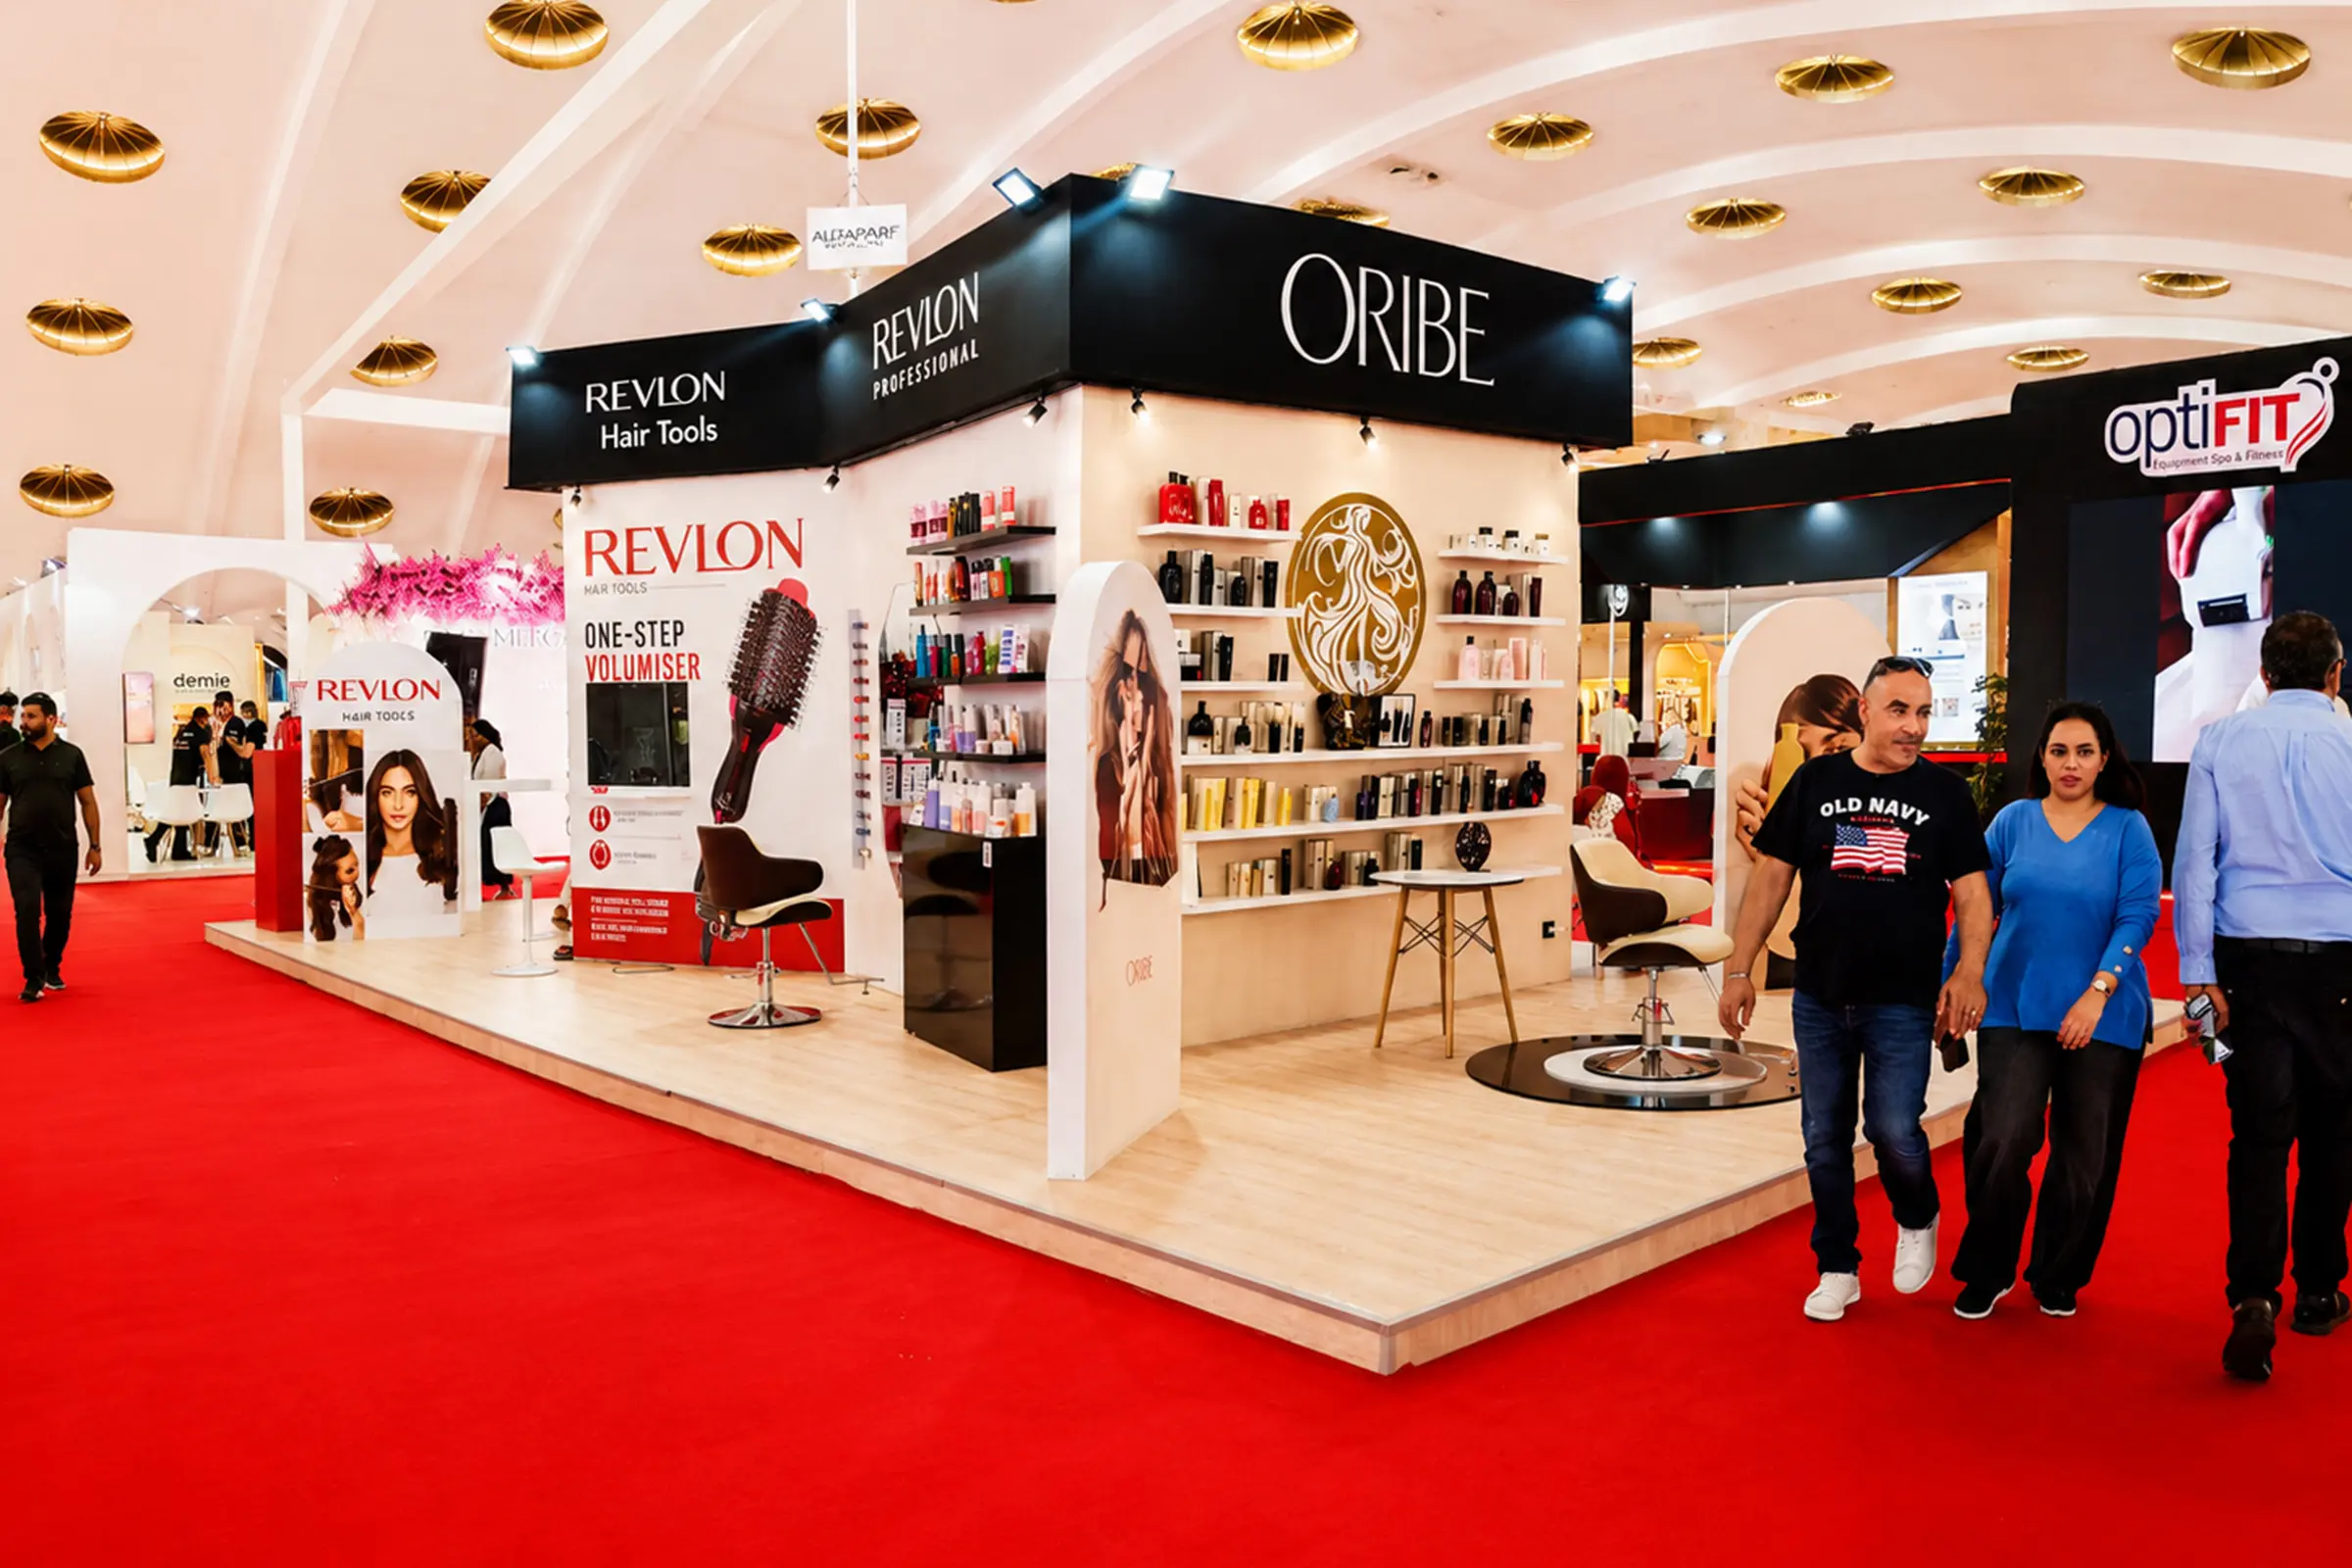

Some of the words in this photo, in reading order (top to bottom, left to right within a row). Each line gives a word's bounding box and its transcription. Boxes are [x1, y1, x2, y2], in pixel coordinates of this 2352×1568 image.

[873, 271, 979, 370] REVLON
[1281, 253, 1494, 386] ORIBE
[873, 339, 979, 400] PROFESSIONAL
[586, 370, 725, 413] REVLON
[601, 422, 651, 449] Hair
[657, 415, 718, 445] Tools
[2110, 386, 2300, 468] optiFIT
[2234, 452, 2242, 462] &
[584, 517, 804, 576] REVLON
[585, 619, 684, 649] ONE-STEP
[173, 672, 230, 688] demie
[585, 653, 701, 682] VOLUMISER
[318, 677, 440, 702] REVLON
[1820, 797, 1863, 817] OLD
[1868, 797, 1930, 825] NAVY
